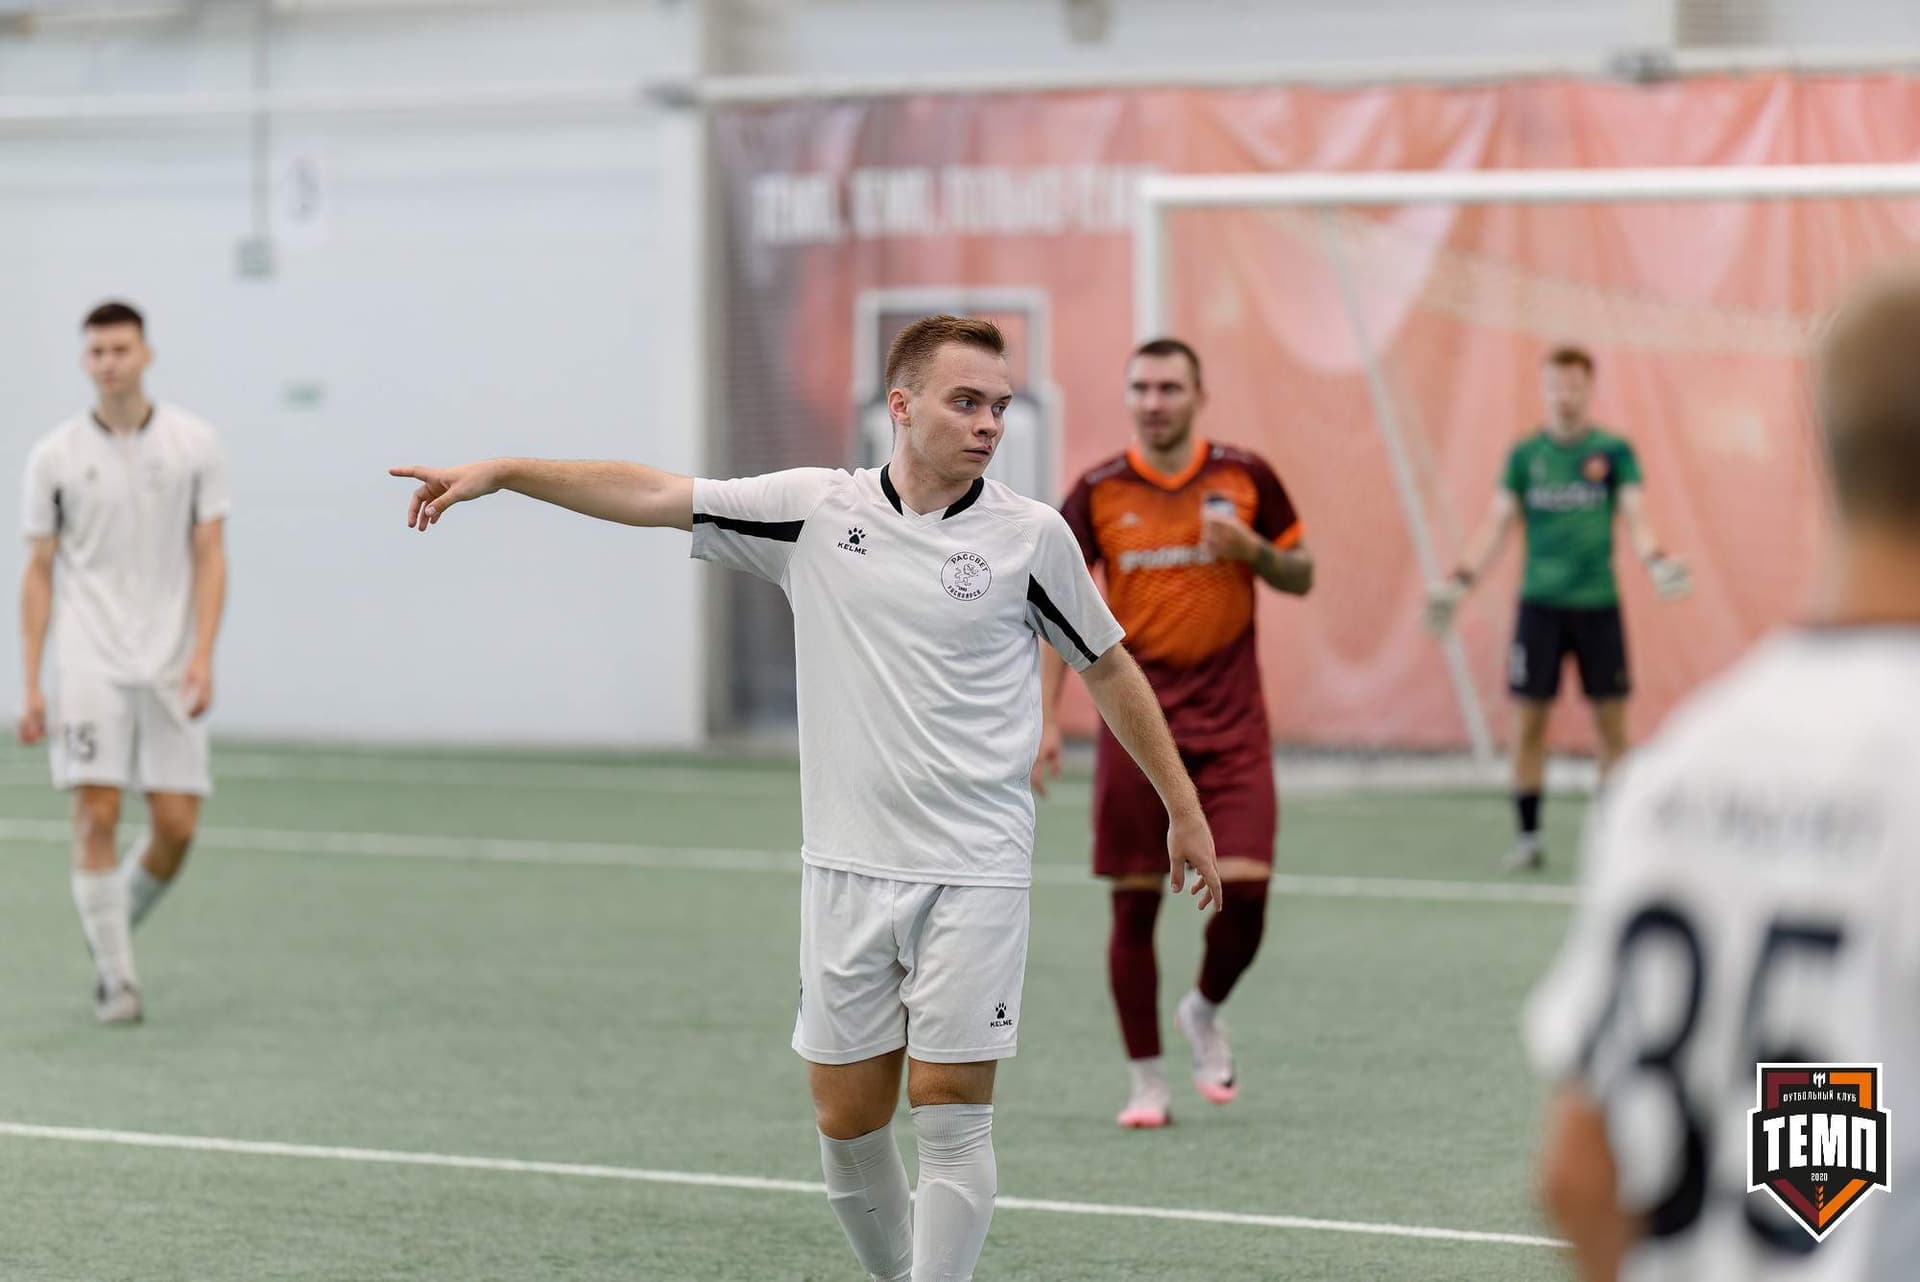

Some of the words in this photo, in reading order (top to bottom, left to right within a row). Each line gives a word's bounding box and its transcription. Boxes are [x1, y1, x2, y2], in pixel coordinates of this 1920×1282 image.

[837, 541, 867, 555] KELME
[950, 553, 988, 572] РАССВЕТ
[990, 1019, 1013, 1028] KELME
